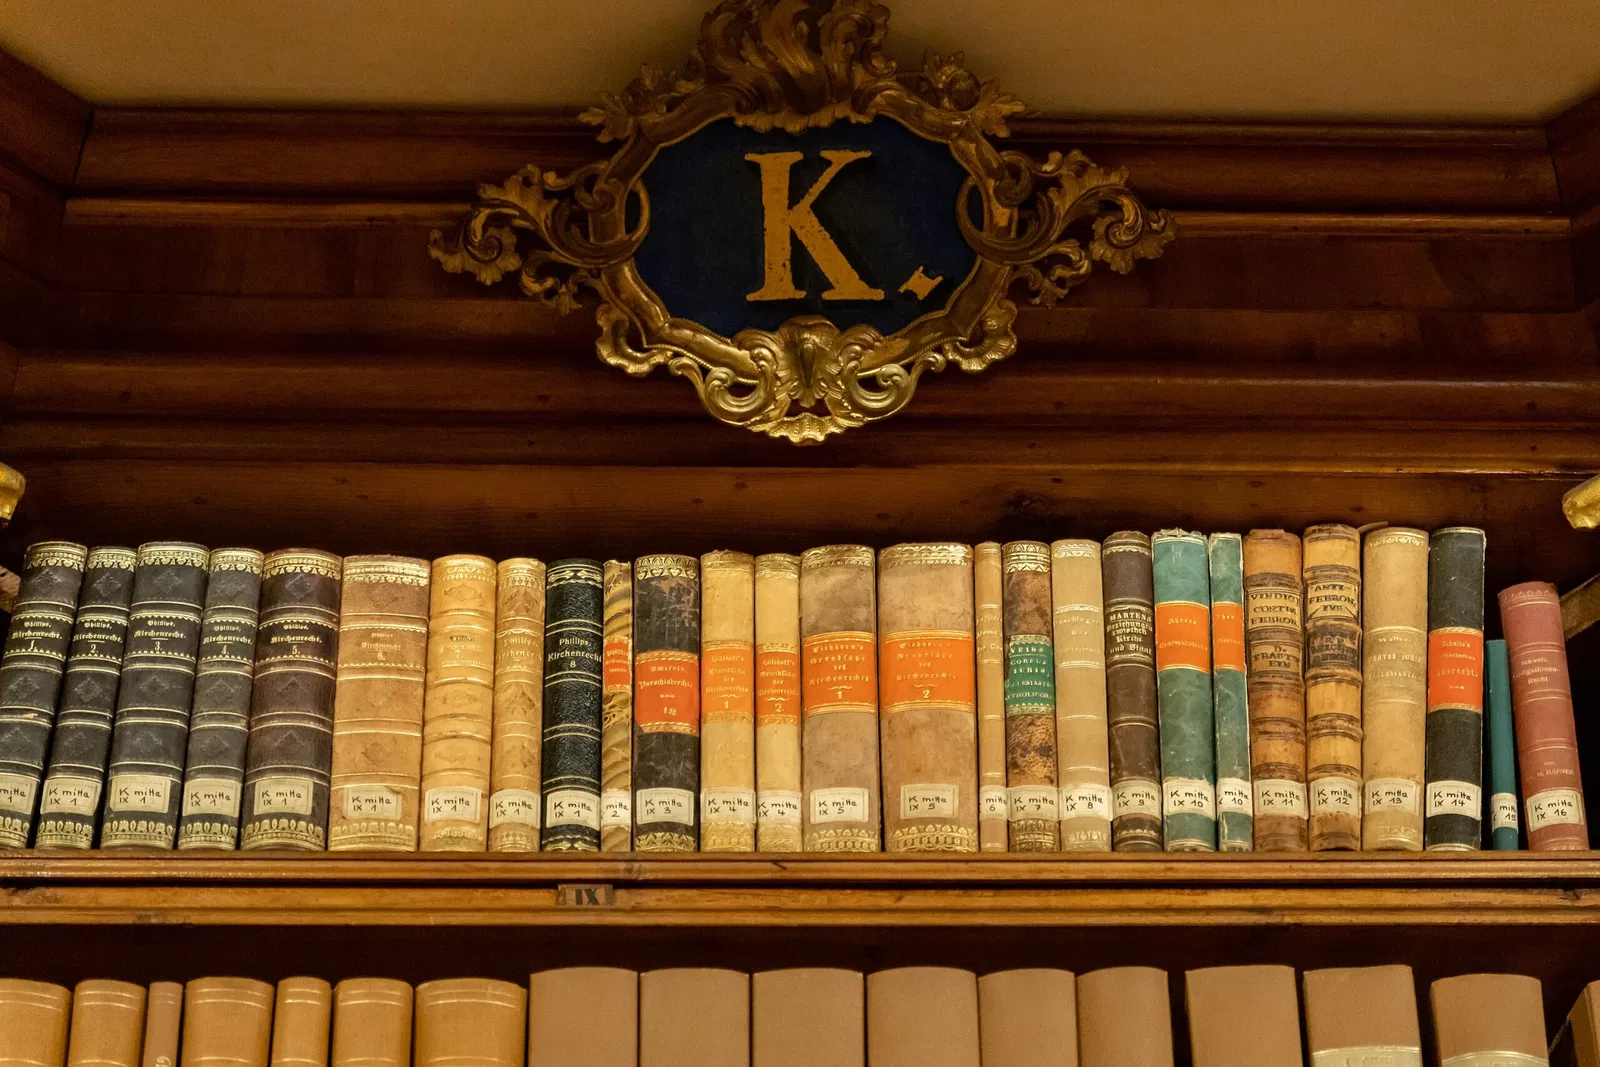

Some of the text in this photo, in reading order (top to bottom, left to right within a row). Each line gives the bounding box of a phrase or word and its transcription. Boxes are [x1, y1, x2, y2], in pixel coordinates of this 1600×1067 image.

[1110, 612, 1152, 622] MARTENS
[12, 630, 62, 640] Kirchenrecht.
[73, 633, 123, 643] Kirchenrecht.
[134, 630, 187, 639] Kirchenrecht.
[1116, 635, 1143, 643] Kirche
[202, 635, 253, 645] Kirchenrecht.
[271, 635, 322, 644] Kirchenrecht.
[559, 637, 591, 647] Phillips,
[90, 644, 99, 653] 2.
[154, 641, 163, 651] 3.
[292, 645, 300, 655] 5.
[1110, 644, 1125, 654] und
[1129, 643, 1152, 656] Staat
[570, 660, 576, 668] 8
[1528, 675, 1549, 684] Recht
[837, 691, 843, 699] 1
[922, 689, 930, 698] 2
[724, 700, 729, 709] 1
[49, 788, 90, 798] K mitte
[120, 788, 161, 797] K mitte
[190, 791, 231, 801] K mitte
[262, 789, 301, 798] K mitte
[1117, 790, 1155, 800] K mitte
[1170, 790, 1180, 798] K
[1185, 790, 1208, 802] mitte
[1224, 789, 1249, 800] mitte
[1262, 790, 1300, 801] K mitte
[1317, 788, 1353, 799] K mitte
[1385, 788, 1408, 798] mitte
[1434, 791, 1471, 800] K mitte
[365, 796, 392, 804] mitte
[431, 797, 470, 806] K mitte
[645, 798, 682, 807] K mitte
[708, 798, 749, 807] K mitte
[832, 797, 857, 807] mitte
[922, 795, 947, 803] mitte
[1066, 793, 1103, 804] K mitte
[1318, 798, 1328, 806] IX
[495, 799, 532, 810] K mitte
[554, 801, 592, 811] K mitte
[606, 802, 628, 810] mitte
[758, 801, 798, 810] K mitte
[1066, 803, 1077, 812] IX
[1535, 800, 1573, 812] K mitte
[496, 809, 506, 818] IX
[759, 810, 769, 818] IX
[1554, 809, 1567, 817] 16
[574, 888, 601, 905] IX
